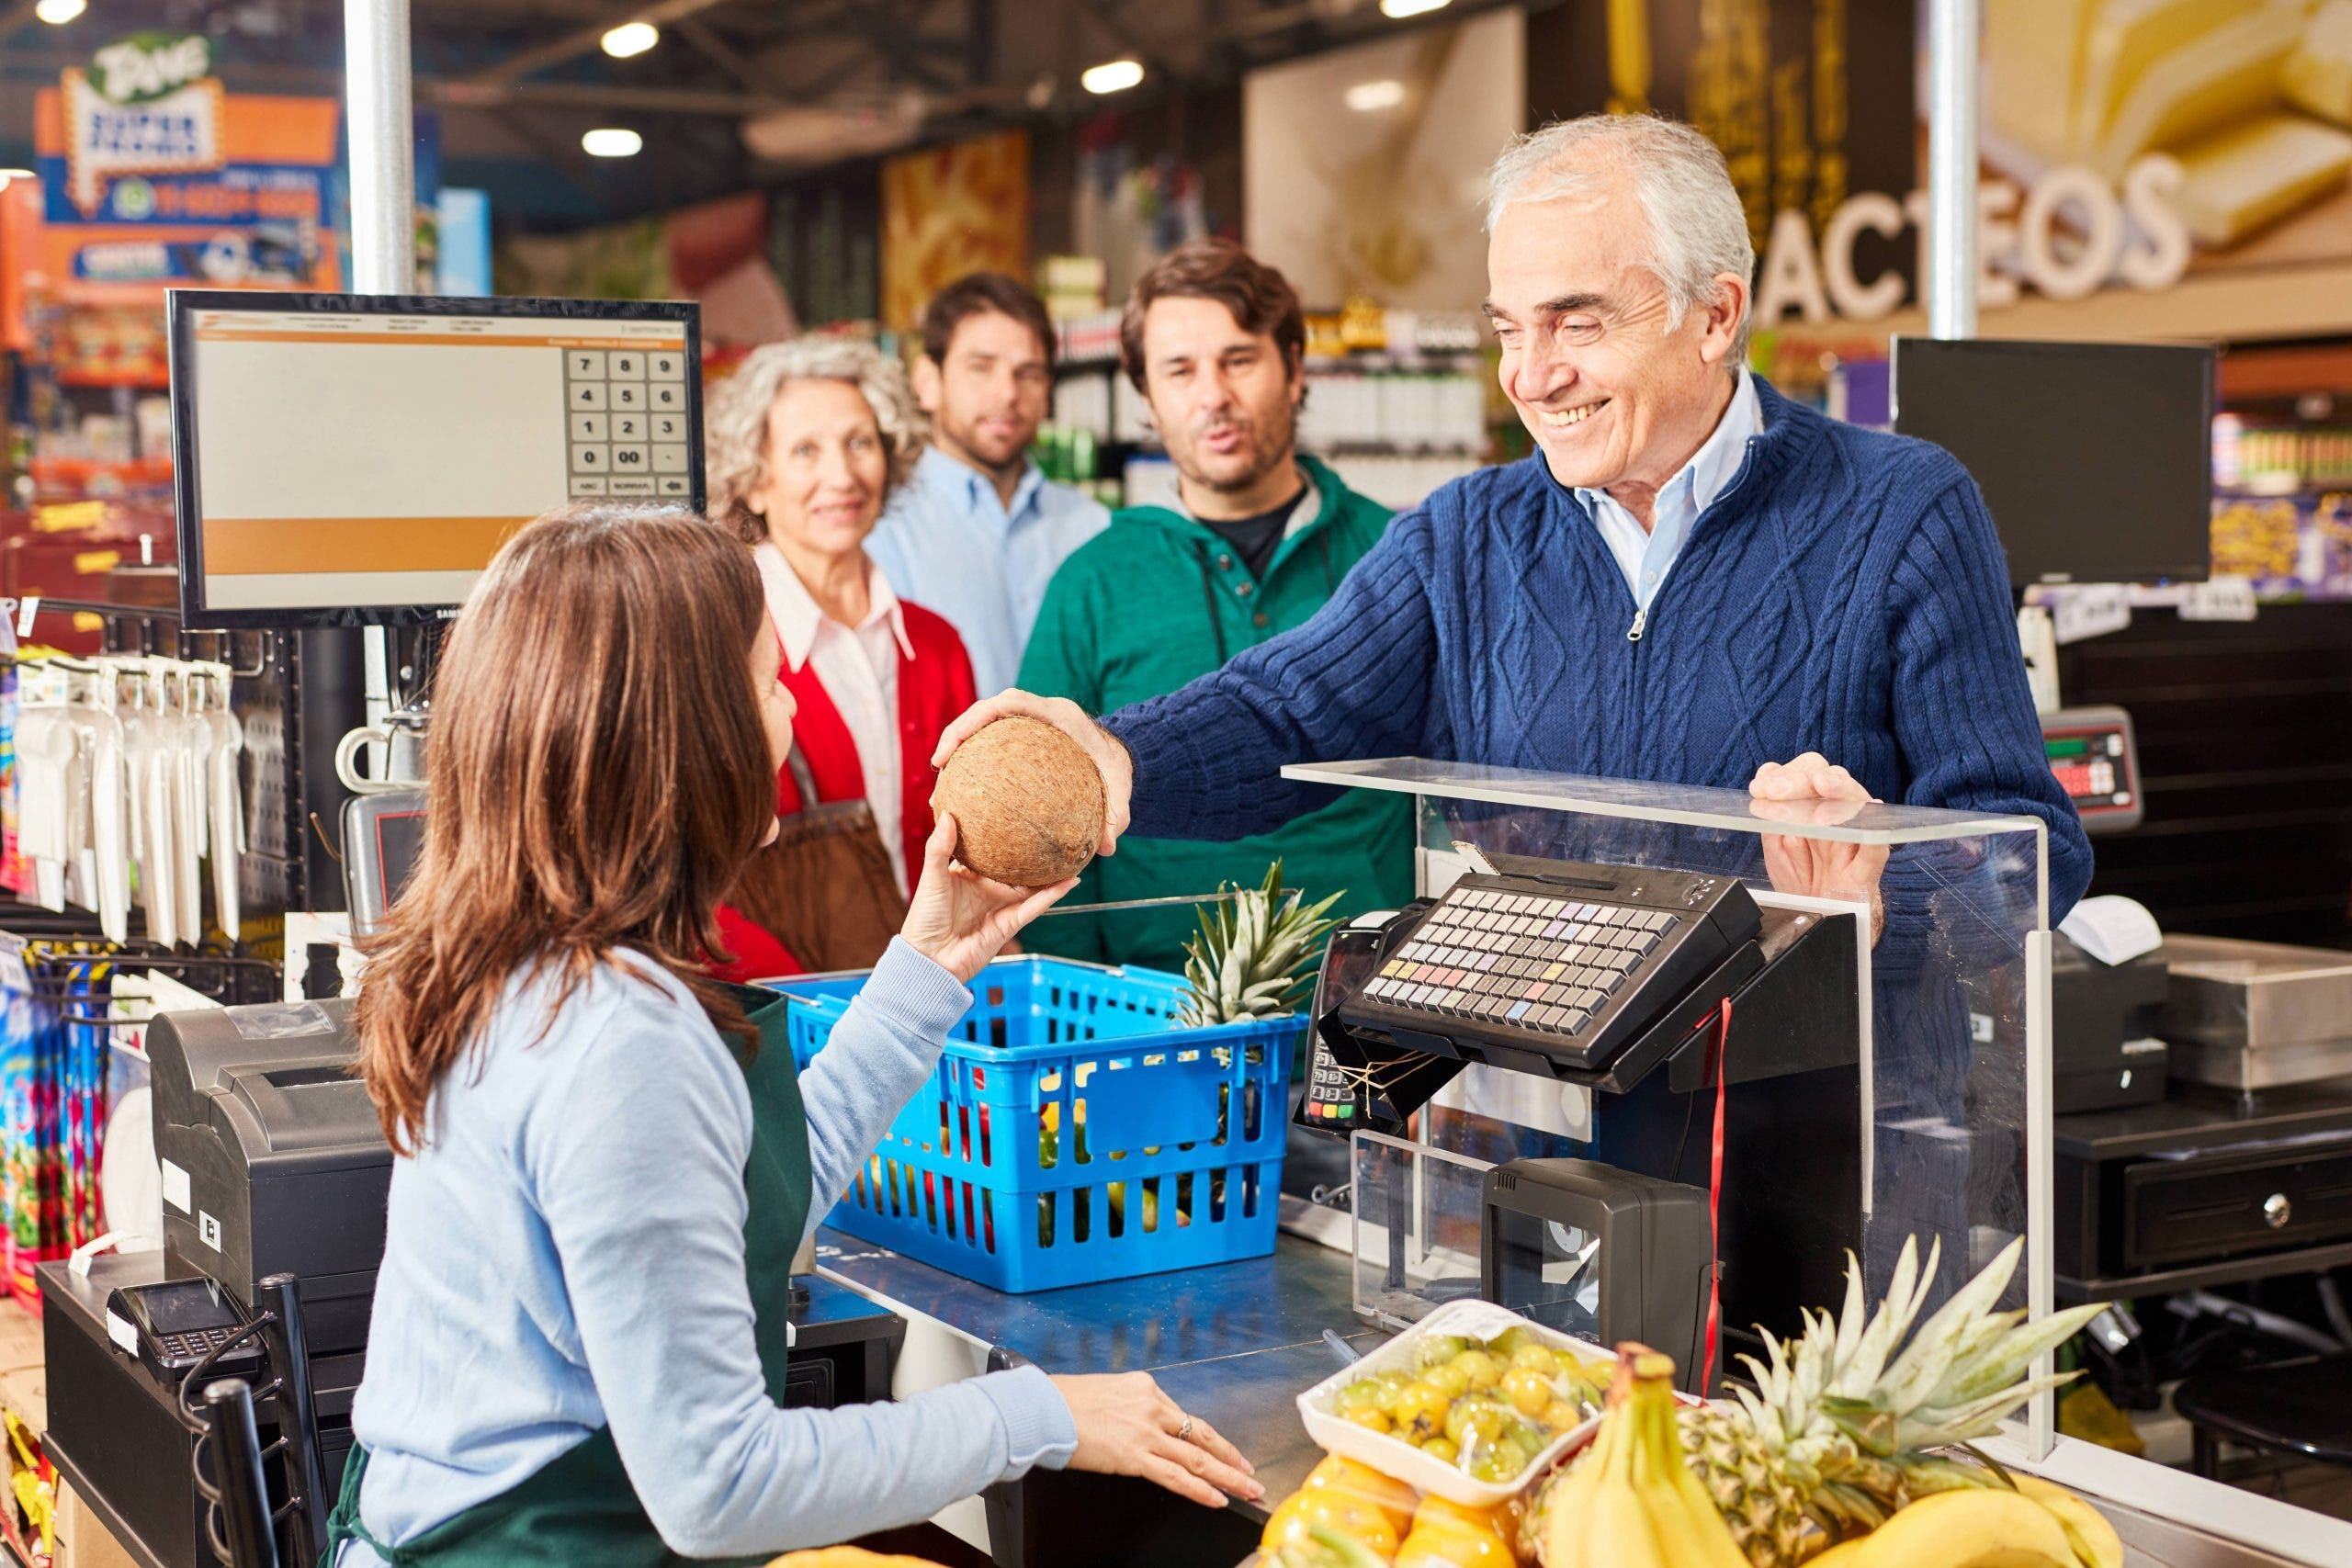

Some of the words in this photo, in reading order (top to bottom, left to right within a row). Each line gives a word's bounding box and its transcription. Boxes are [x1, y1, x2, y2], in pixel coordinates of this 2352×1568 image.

[581, 359, 590, 370] 7
[620, 359, 630, 371] 8
[660, 360, 670, 372] 9
[582, 390, 593, 401] 4
[622, 390, 632, 402] 5
[661, 390, 671, 402] 6
[583, 421, 593, 433] 1
[623, 422, 633, 433] 2
[662, 421, 673, 433] 3
[584, 451, 594, 463] 0
[618, 451, 639, 463] 00
